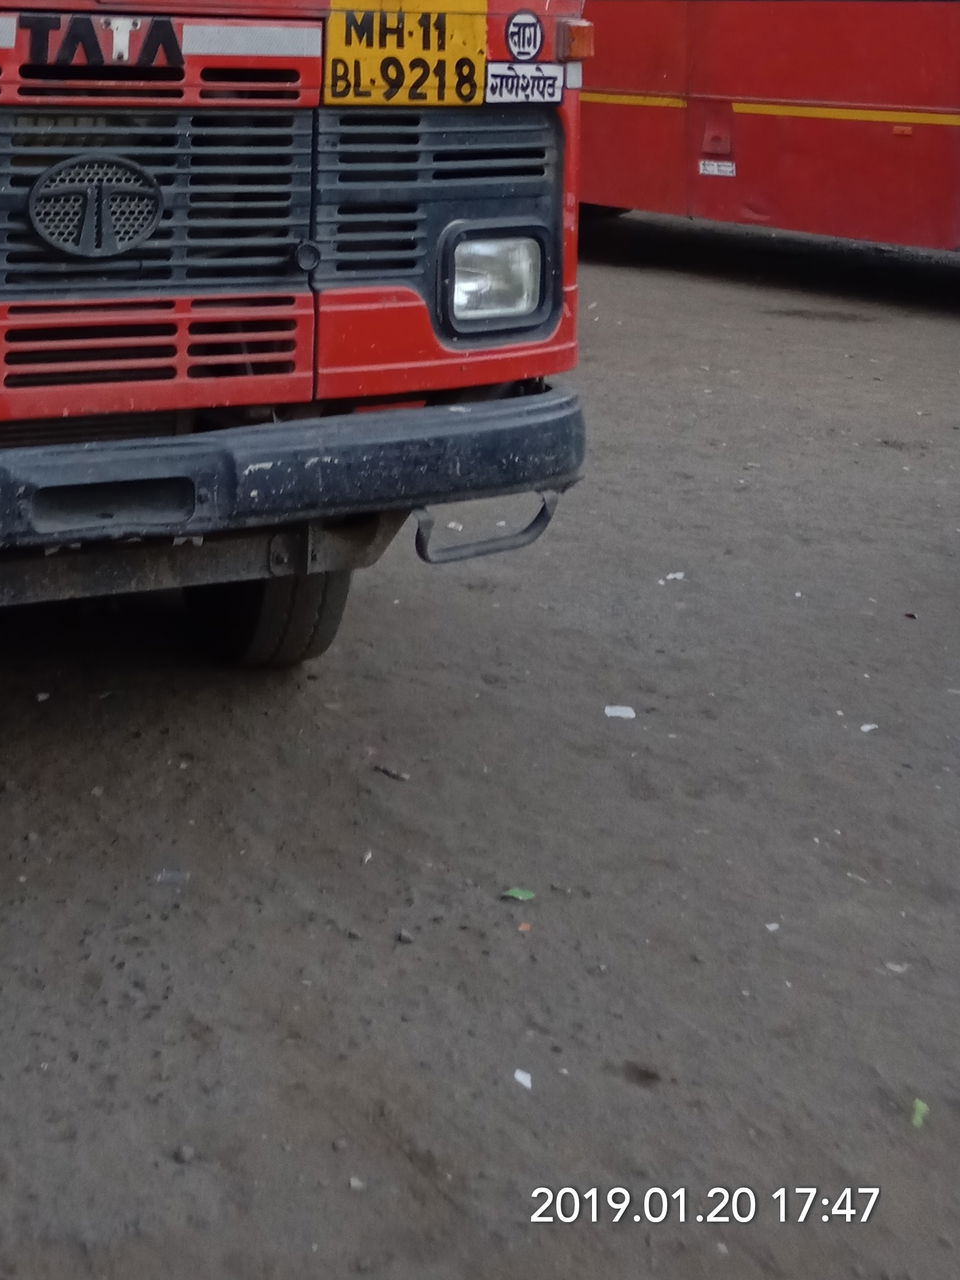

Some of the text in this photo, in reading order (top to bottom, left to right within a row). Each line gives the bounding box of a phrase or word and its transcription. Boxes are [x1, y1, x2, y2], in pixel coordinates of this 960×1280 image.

[19, 14, 185, 66] TATA
[509, 22, 537, 50] नाग
[490, 65, 558, 101] गणेशपेठ
